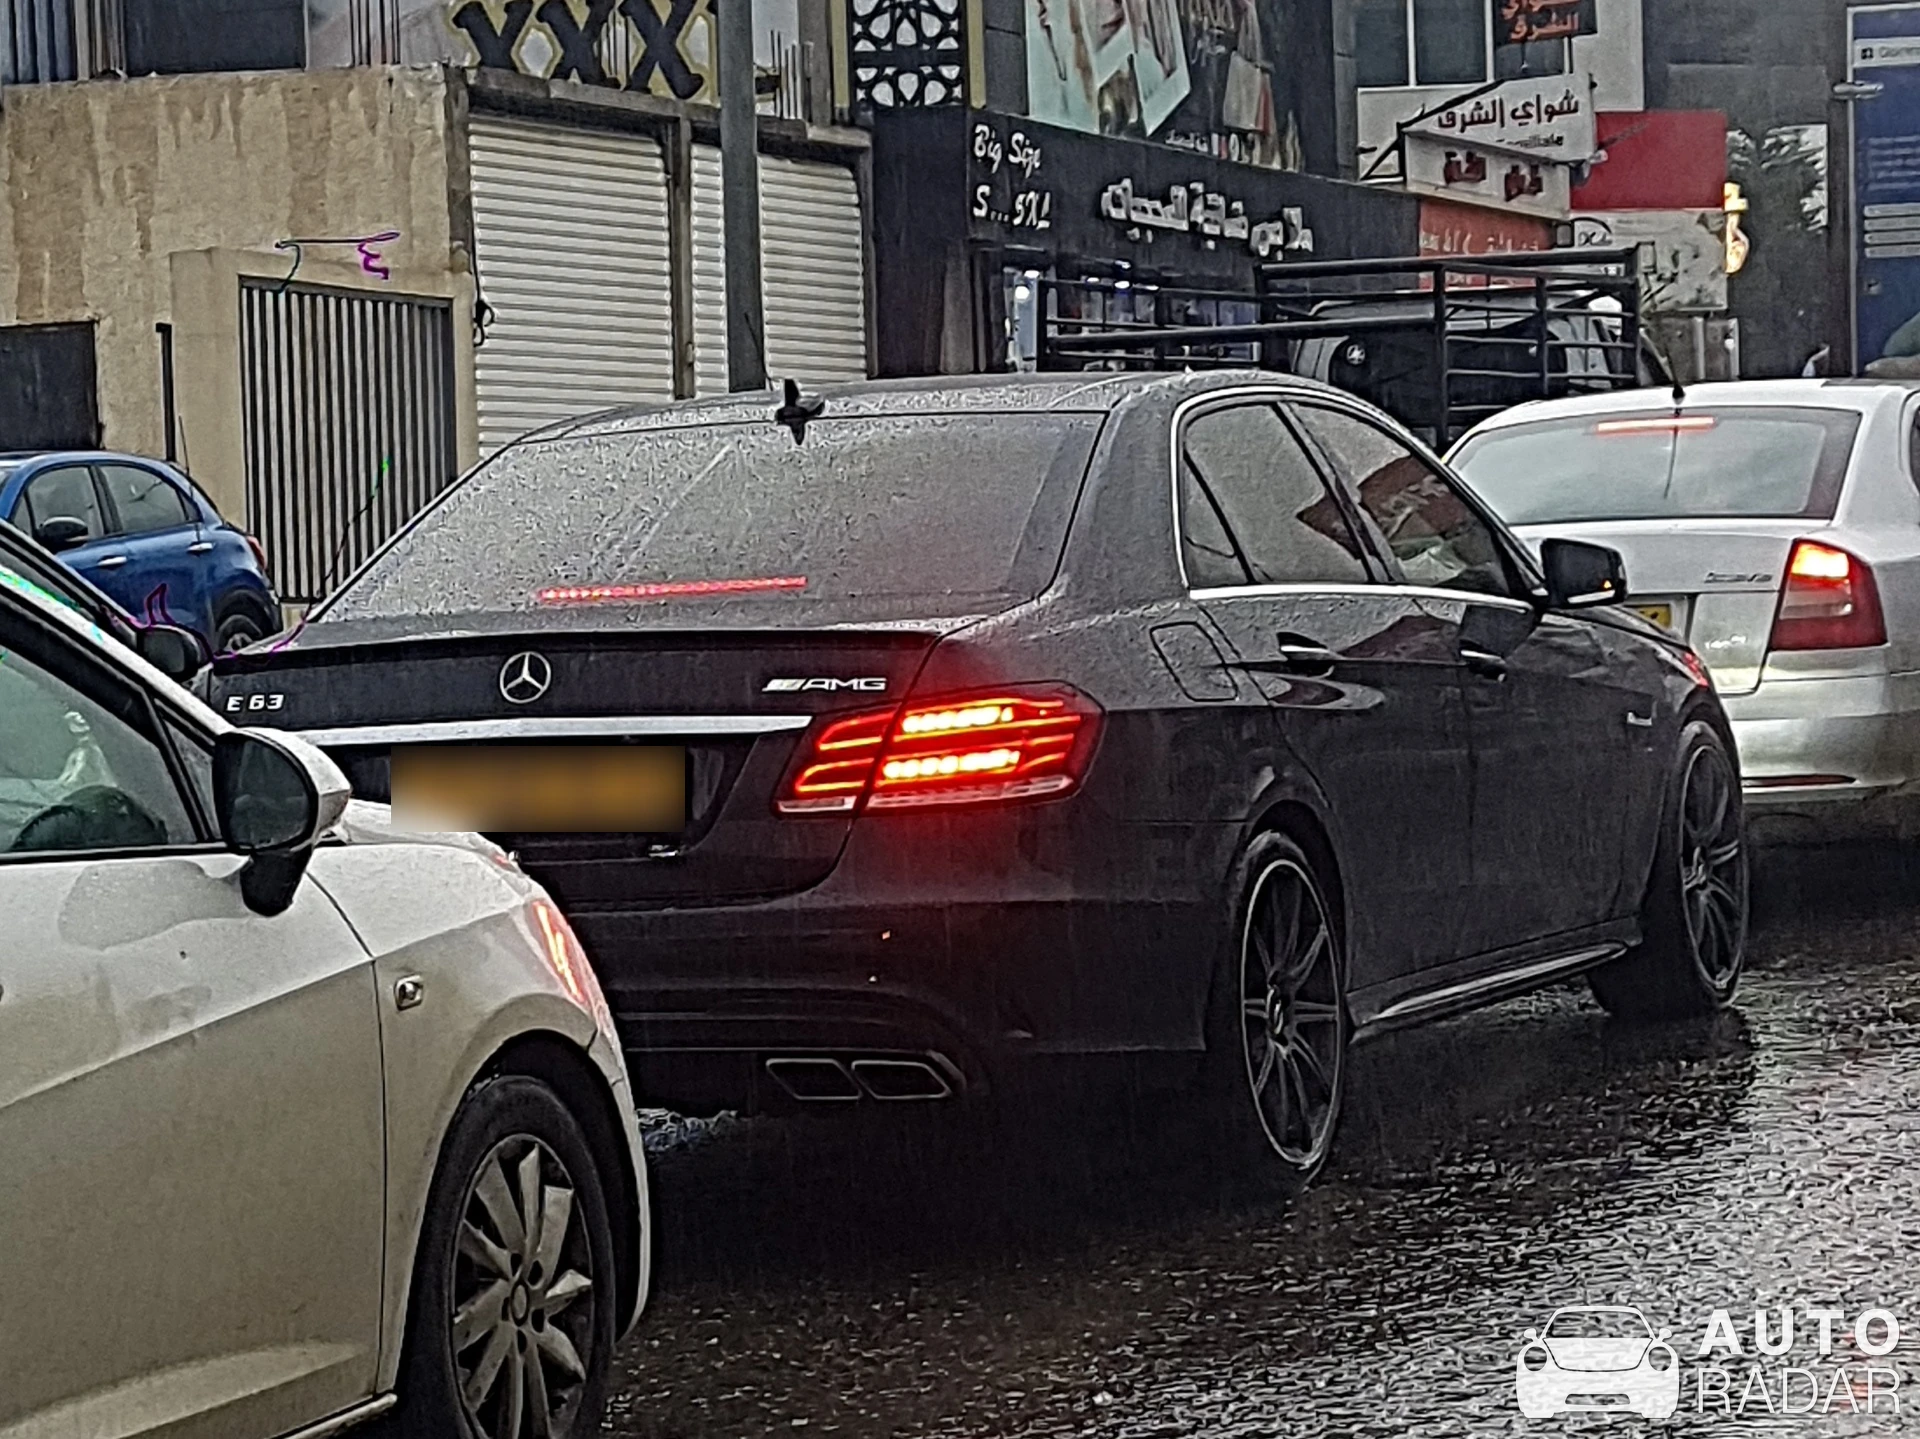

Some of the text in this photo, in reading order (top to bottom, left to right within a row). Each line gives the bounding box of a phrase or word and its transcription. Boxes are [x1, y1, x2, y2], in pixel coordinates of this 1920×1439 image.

[1510, 89, 1579, 126] شواي
[974, 124, 1002, 174] Big
[801, 677, 887, 692] AMG
[226, 694, 284, 711] E 63
